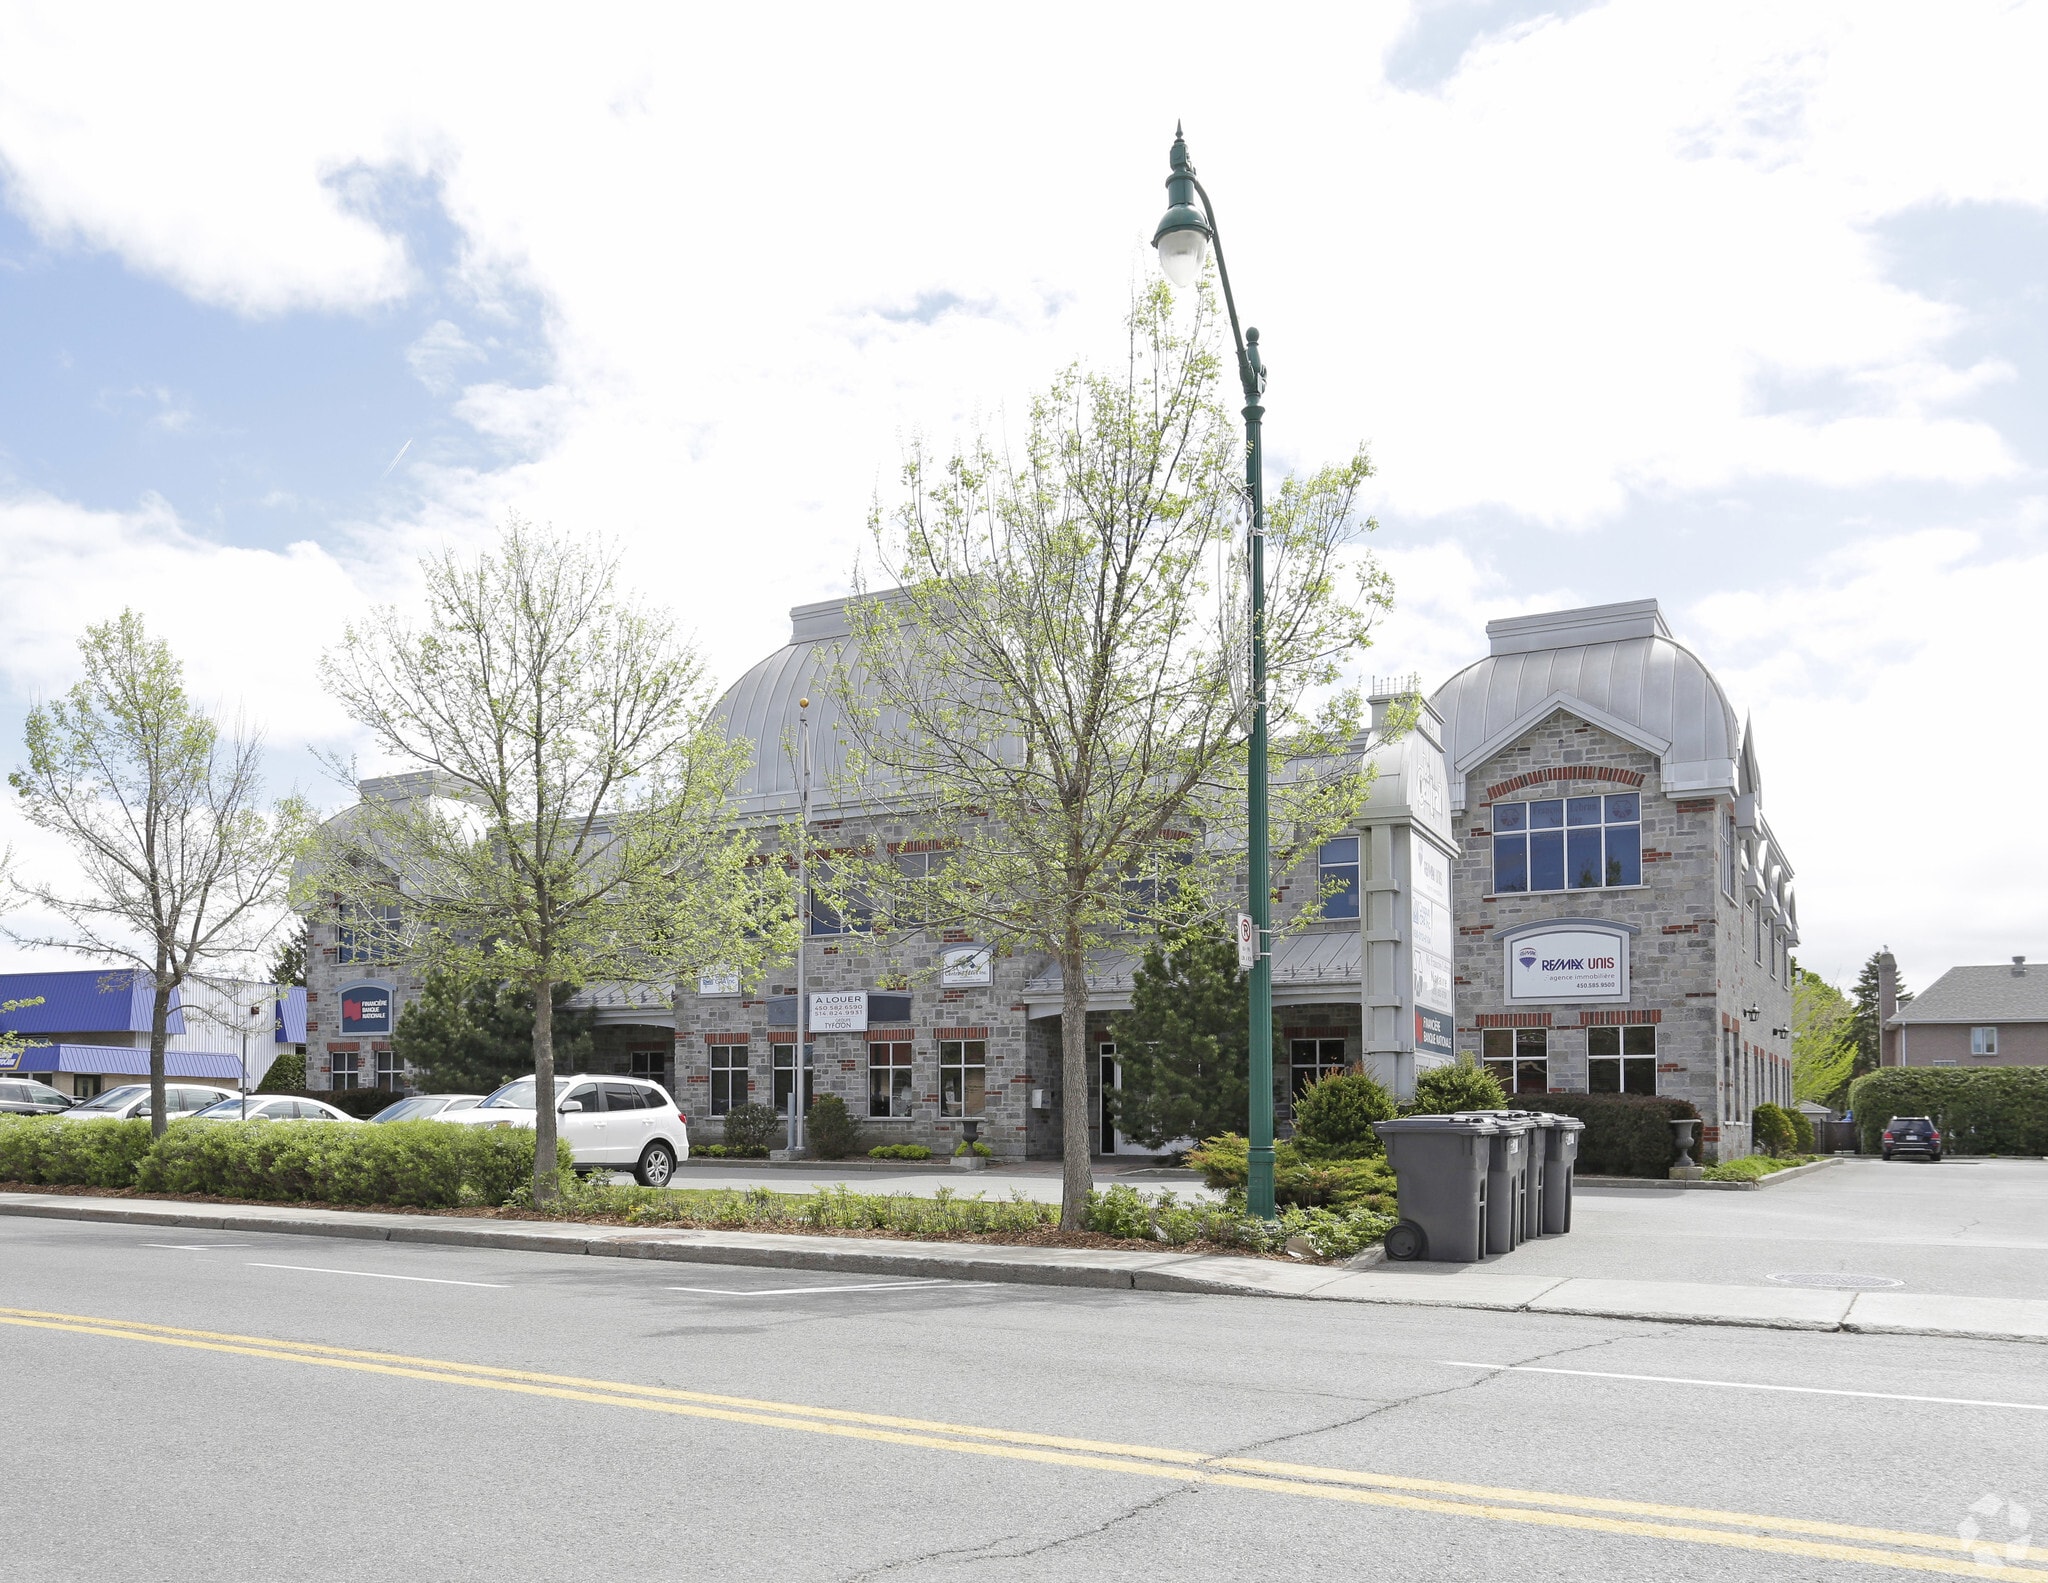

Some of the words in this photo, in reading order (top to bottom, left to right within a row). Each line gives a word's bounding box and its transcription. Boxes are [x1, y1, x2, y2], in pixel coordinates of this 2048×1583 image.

[1541, 958, 1584, 971] RE/MAX
[1587, 957, 1615, 970] UNIS
[1549, 974, 1573, 982] agence
[1574, 972, 1616, 981] immobilière
[815, 995, 823, 1004] À
[826, 995, 862, 1004] LOUER
